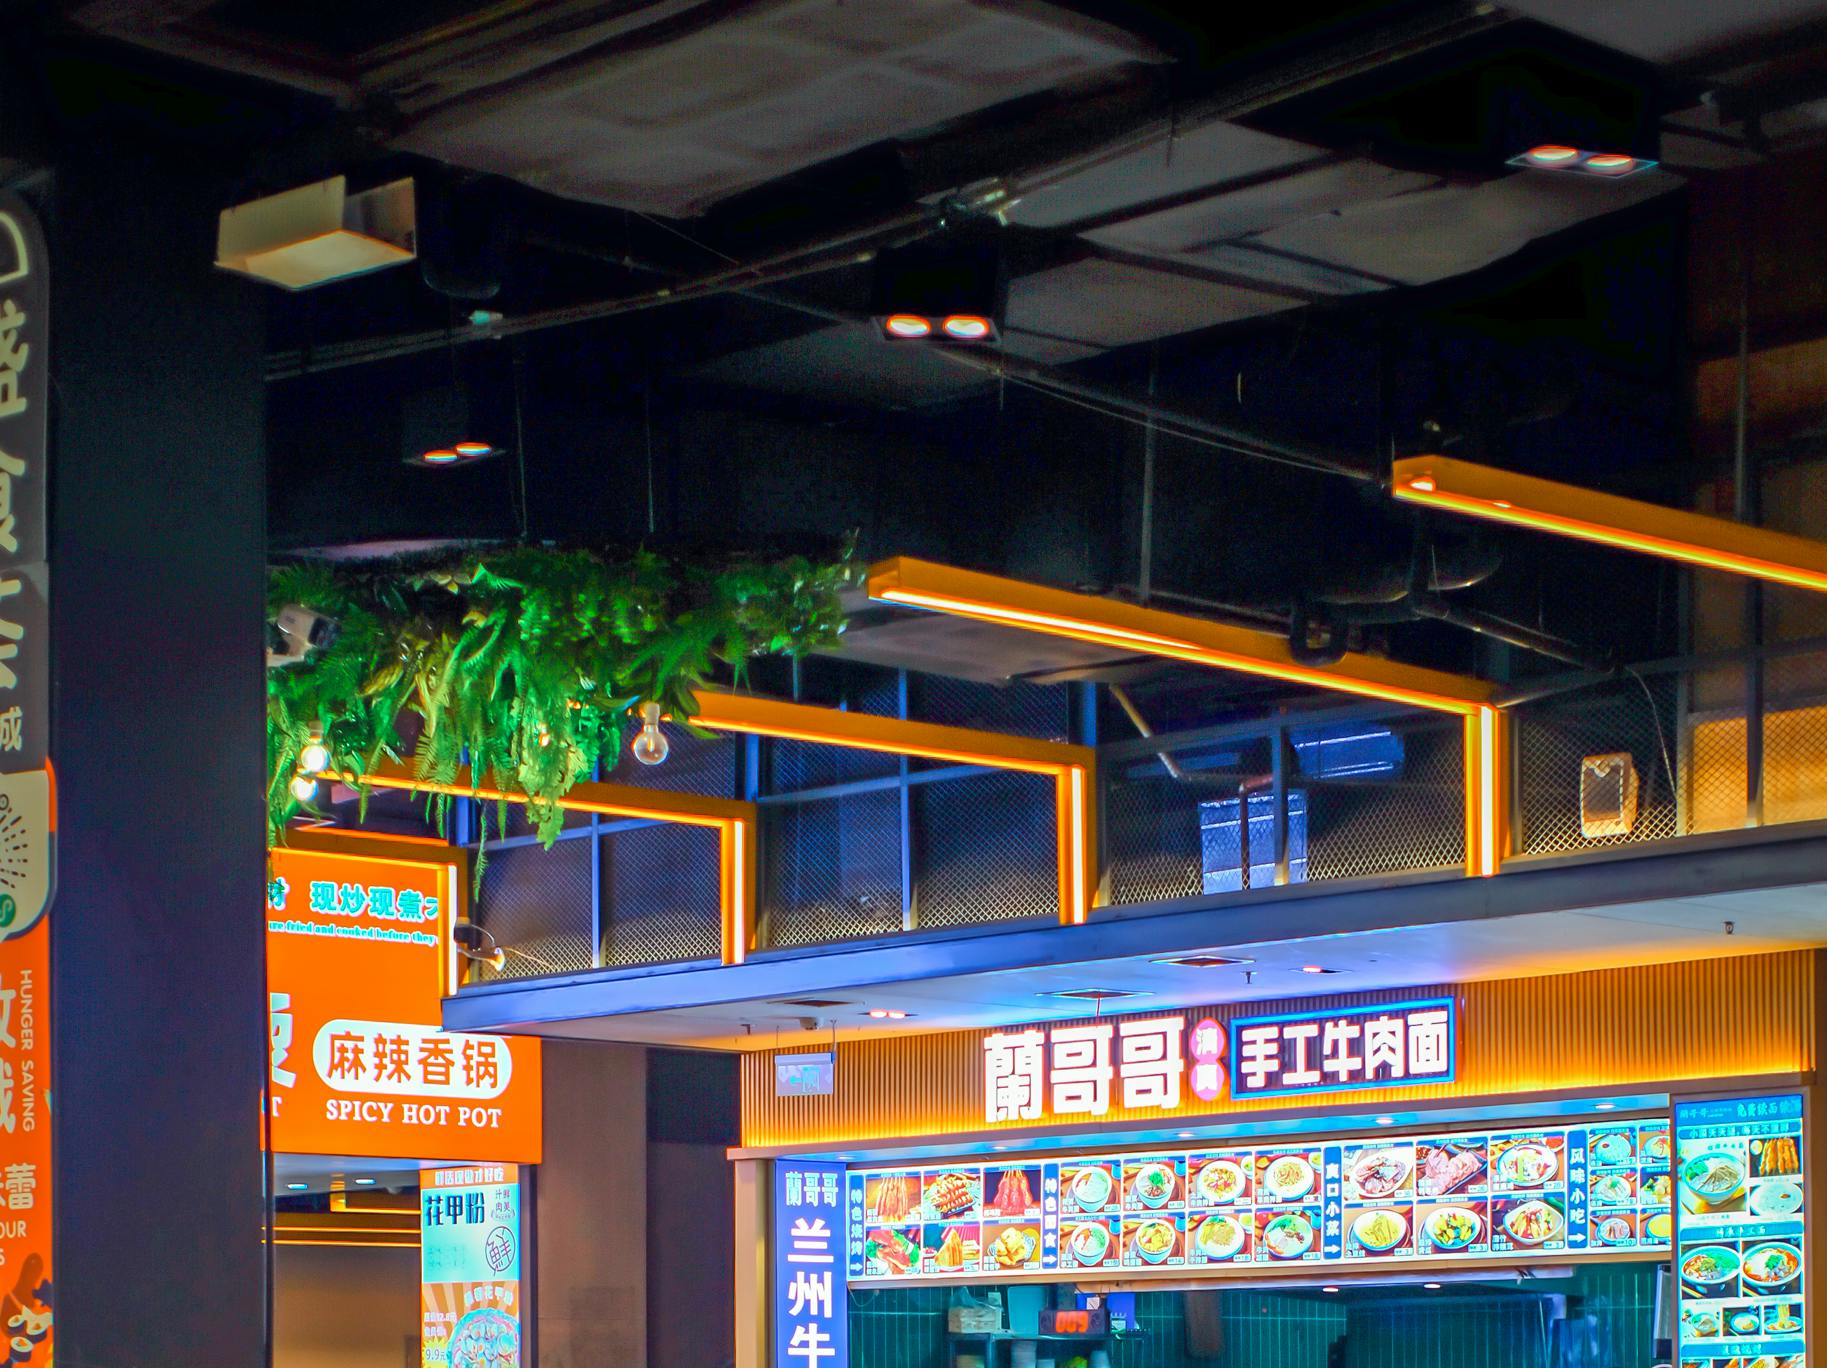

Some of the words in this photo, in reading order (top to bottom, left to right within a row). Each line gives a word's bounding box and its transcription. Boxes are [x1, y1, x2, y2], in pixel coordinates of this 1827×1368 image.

[286, 921, 312, 933] fried
[315, 924, 334, 934] and
[336, 925, 374, 938] cooked
[376, 928, 409, 941] before
[412, 931, 435, 945] they
[20, 969, 33, 1051] HUNGER
[326, 1031, 498, 1089] 麻辣香锅
[1240, 1010, 1448, 1088] 手工牛肉面
[21, 1059, 35, 1132] SAVING
[326, 1099, 394, 1123] SPICY
[402, 1103, 450, 1126] HOT
[458, 1106, 502, 1129] POT
[425, 1192, 485, 1226] 花甲粉
